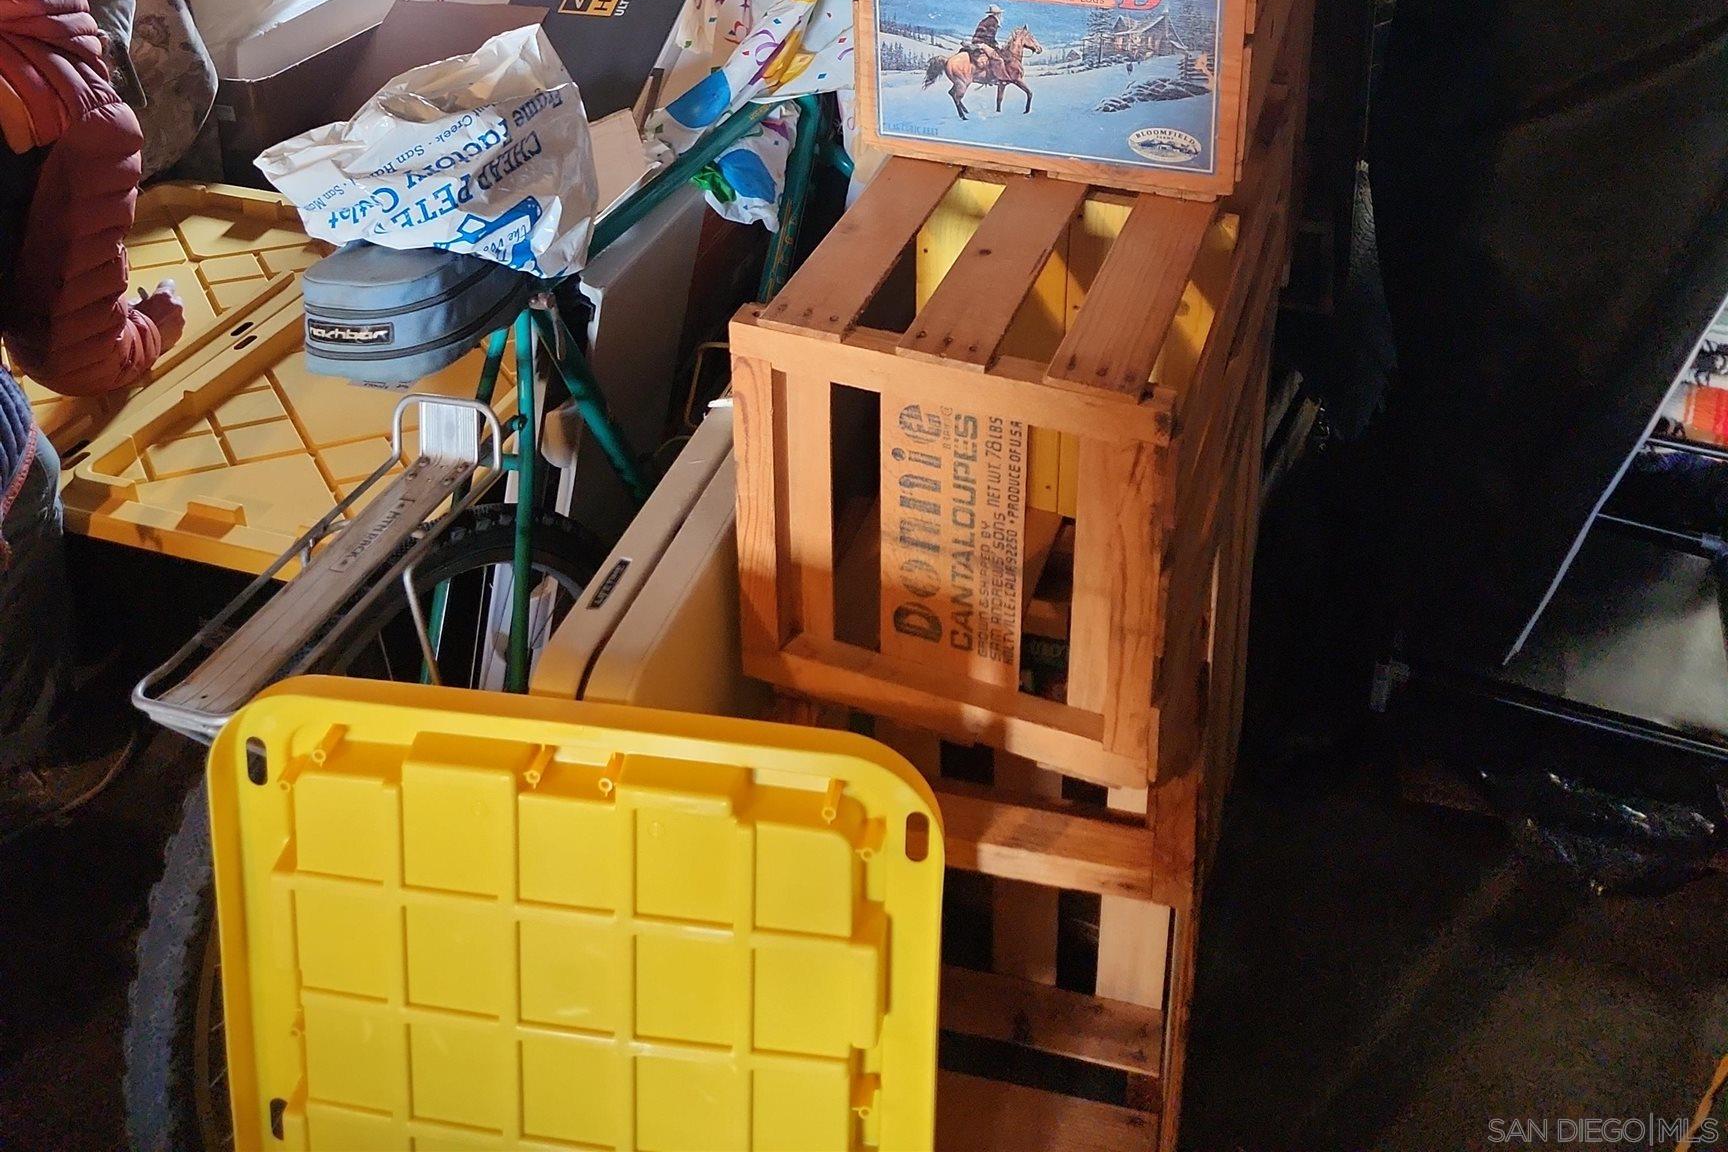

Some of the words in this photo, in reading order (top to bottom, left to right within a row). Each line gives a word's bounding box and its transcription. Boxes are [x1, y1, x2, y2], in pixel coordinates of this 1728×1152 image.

[435, 114, 473, 143] Creek
[1134, 129, 1197, 145] BLOOMFIELD
[396, 144, 425, 164] San
[322, 184, 345, 200] San
[986, 484, 1001, 508] NET
[1007, 464, 1022, 521] PRODUCE
[891, 404, 943, 644] Donnie
[949, 414, 978, 653] CANTALOUPES
[993, 512, 1007, 552] SONS
